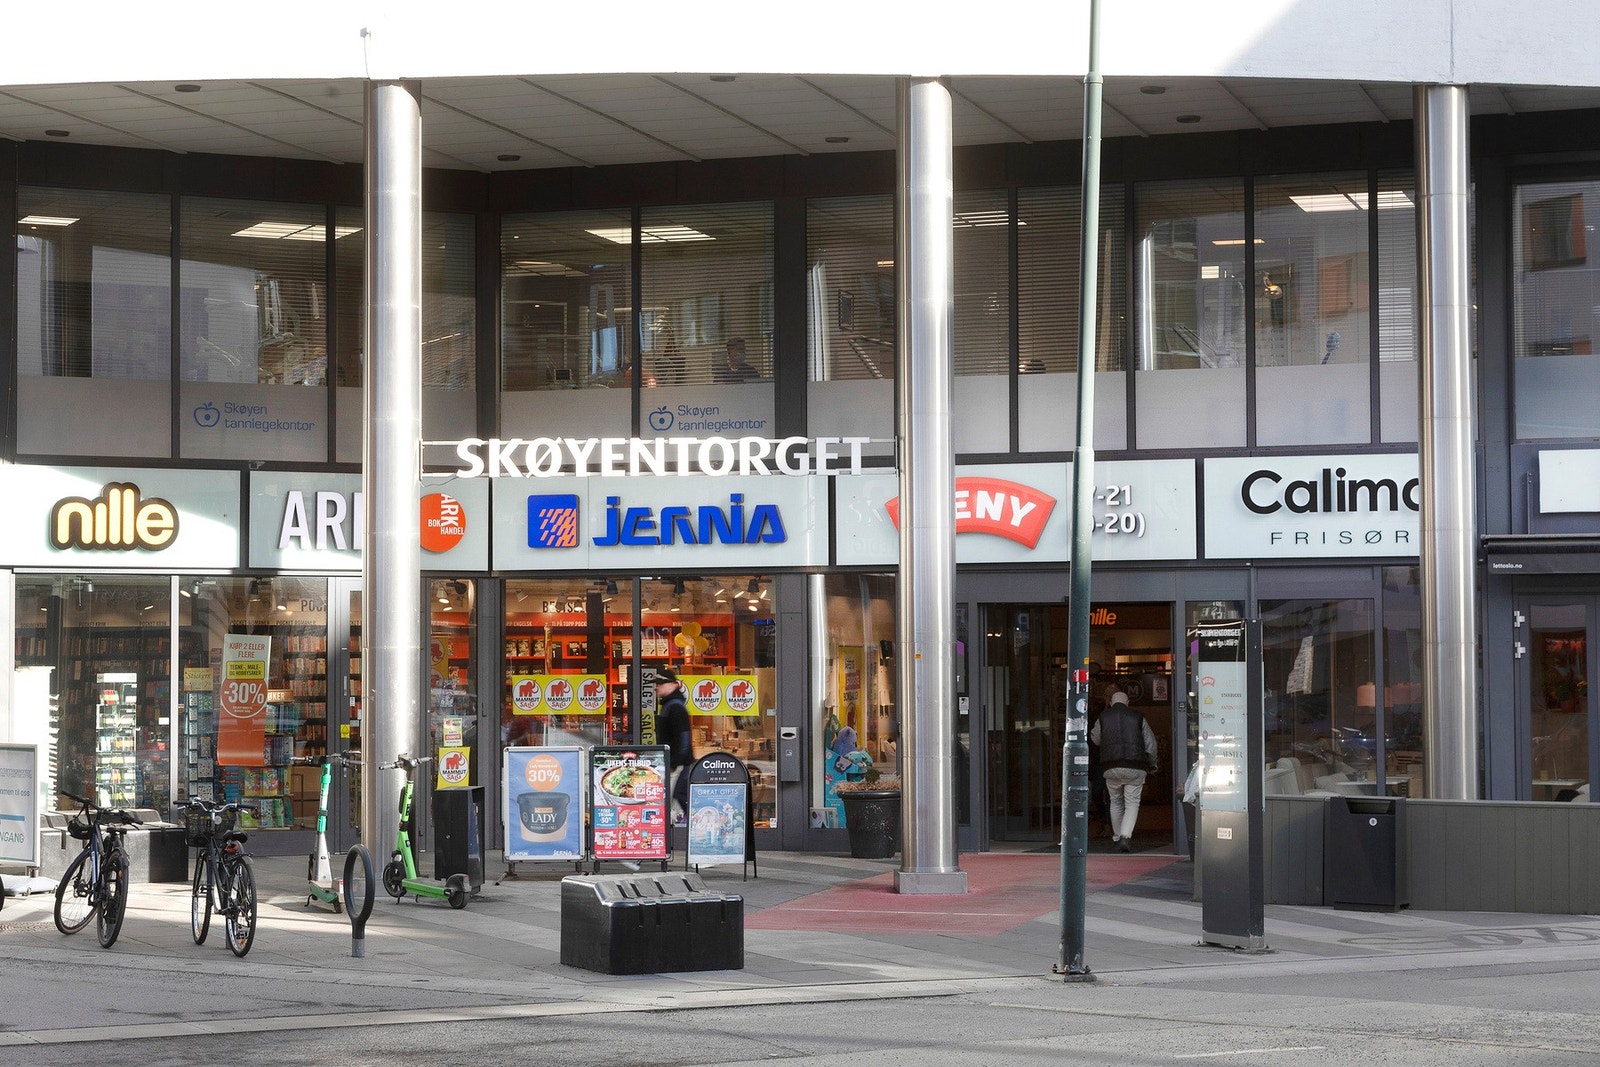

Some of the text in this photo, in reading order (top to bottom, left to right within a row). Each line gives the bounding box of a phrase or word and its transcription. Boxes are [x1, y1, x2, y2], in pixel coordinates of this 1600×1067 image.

[224, 402, 268, 416] Skøyen
[677, 405, 720, 418] Skøyen
[224, 418, 316, 432] tannlegekontor
[678, 419, 767, 432] tannlegekontor
[455, 436, 870, 478] SKØYENTORGET
[1092, 485, 1132, 506] -21
[441, 493, 459, 527] ARK
[956, 490, 1037, 527] ENY
[55, 484, 176, 547] nille
[428, 519, 441, 527] BOK
[1092, 512, 1147, 538] -20)
[441, 527, 464, 535] HANDEL
[1271, 530, 1410, 545] FRISØR
[248, 643, 265, 651] ELLER
[224, 682, 265, 704] -30%
[267, 692, 285, 700] ØKER
[520, 701, 535, 710] SALG
[552, 701, 567, 710] SALG
[584, 701, 599, 710] SALG
[699, 702, 715, 710] SALG
[733, 702, 749, 710] SALG
[642, 714, 652, 739] SALG
[702, 760, 735, 769] Calima
[528, 769, 560, 782] 30%
[531, 813, 557, 823] LADY
